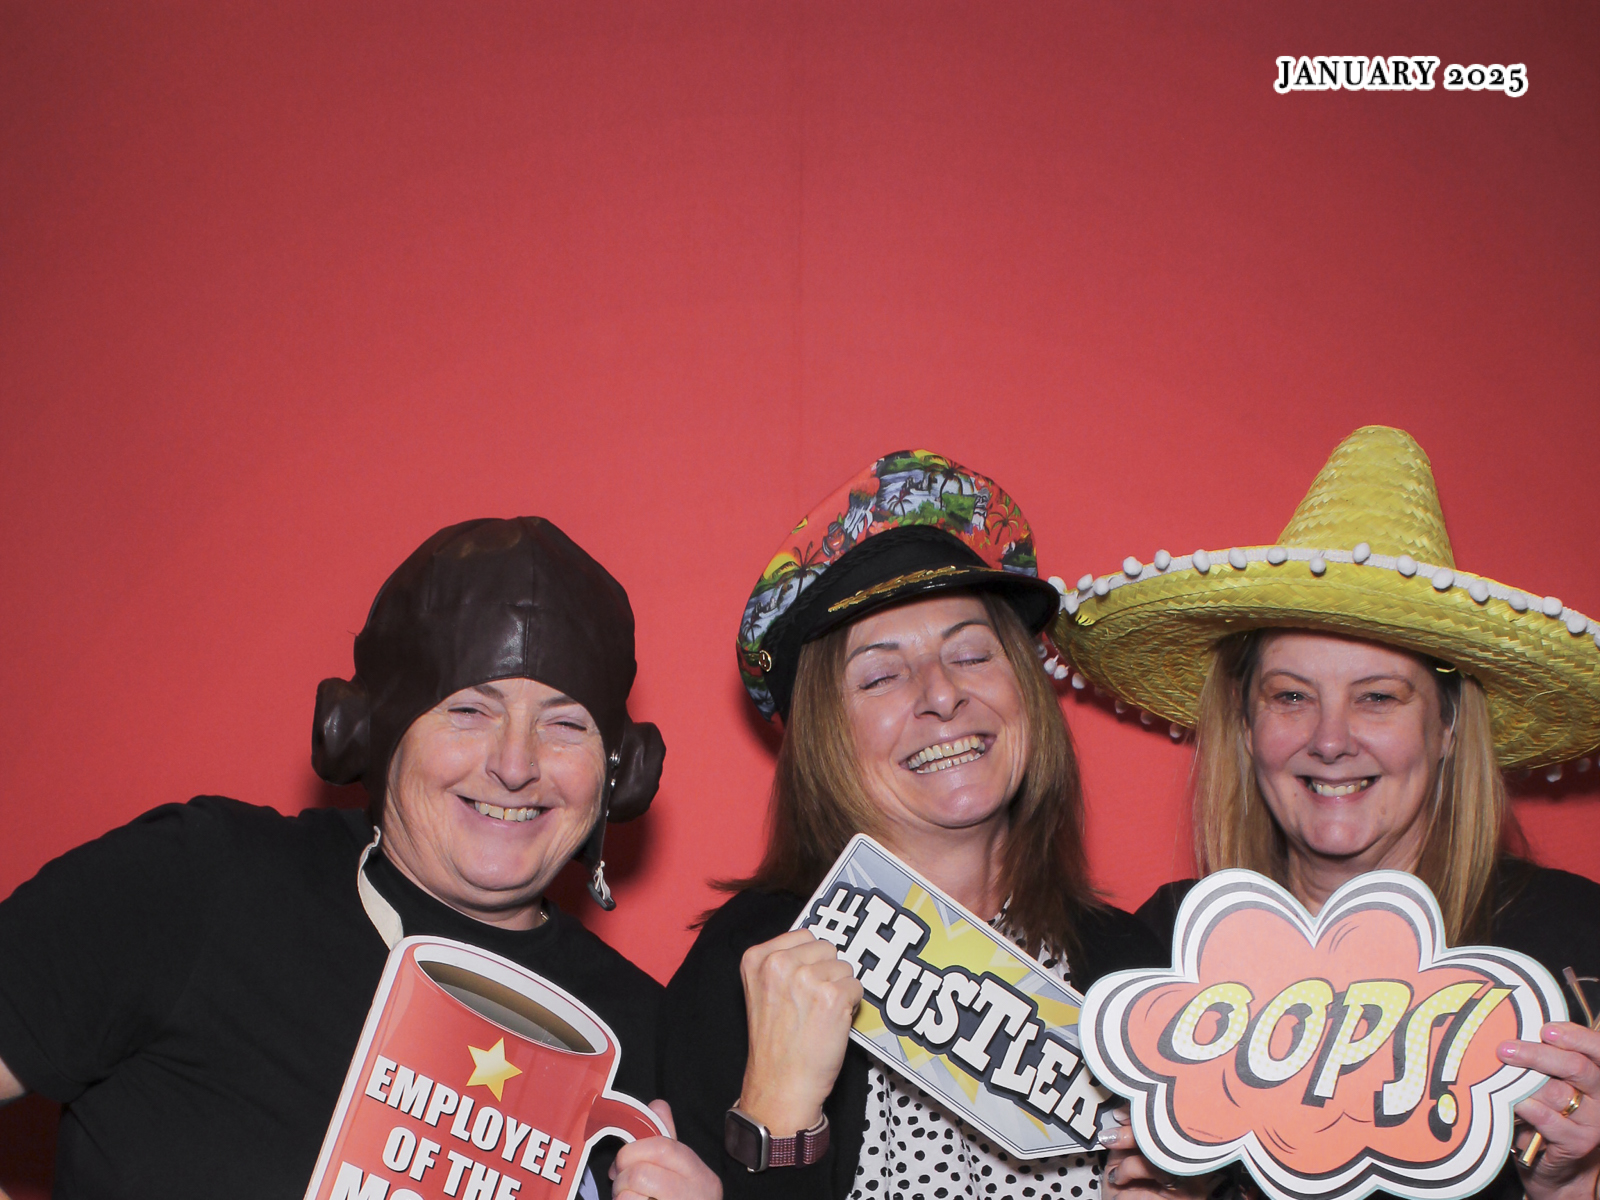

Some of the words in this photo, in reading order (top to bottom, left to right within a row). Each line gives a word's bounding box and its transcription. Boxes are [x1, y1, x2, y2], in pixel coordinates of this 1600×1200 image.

[363, 1053, 572, 1185] EMPLOYEE
[1160, 979, 1519, 1138] OOPS!
[381, 1126, 442, 1182] OF
